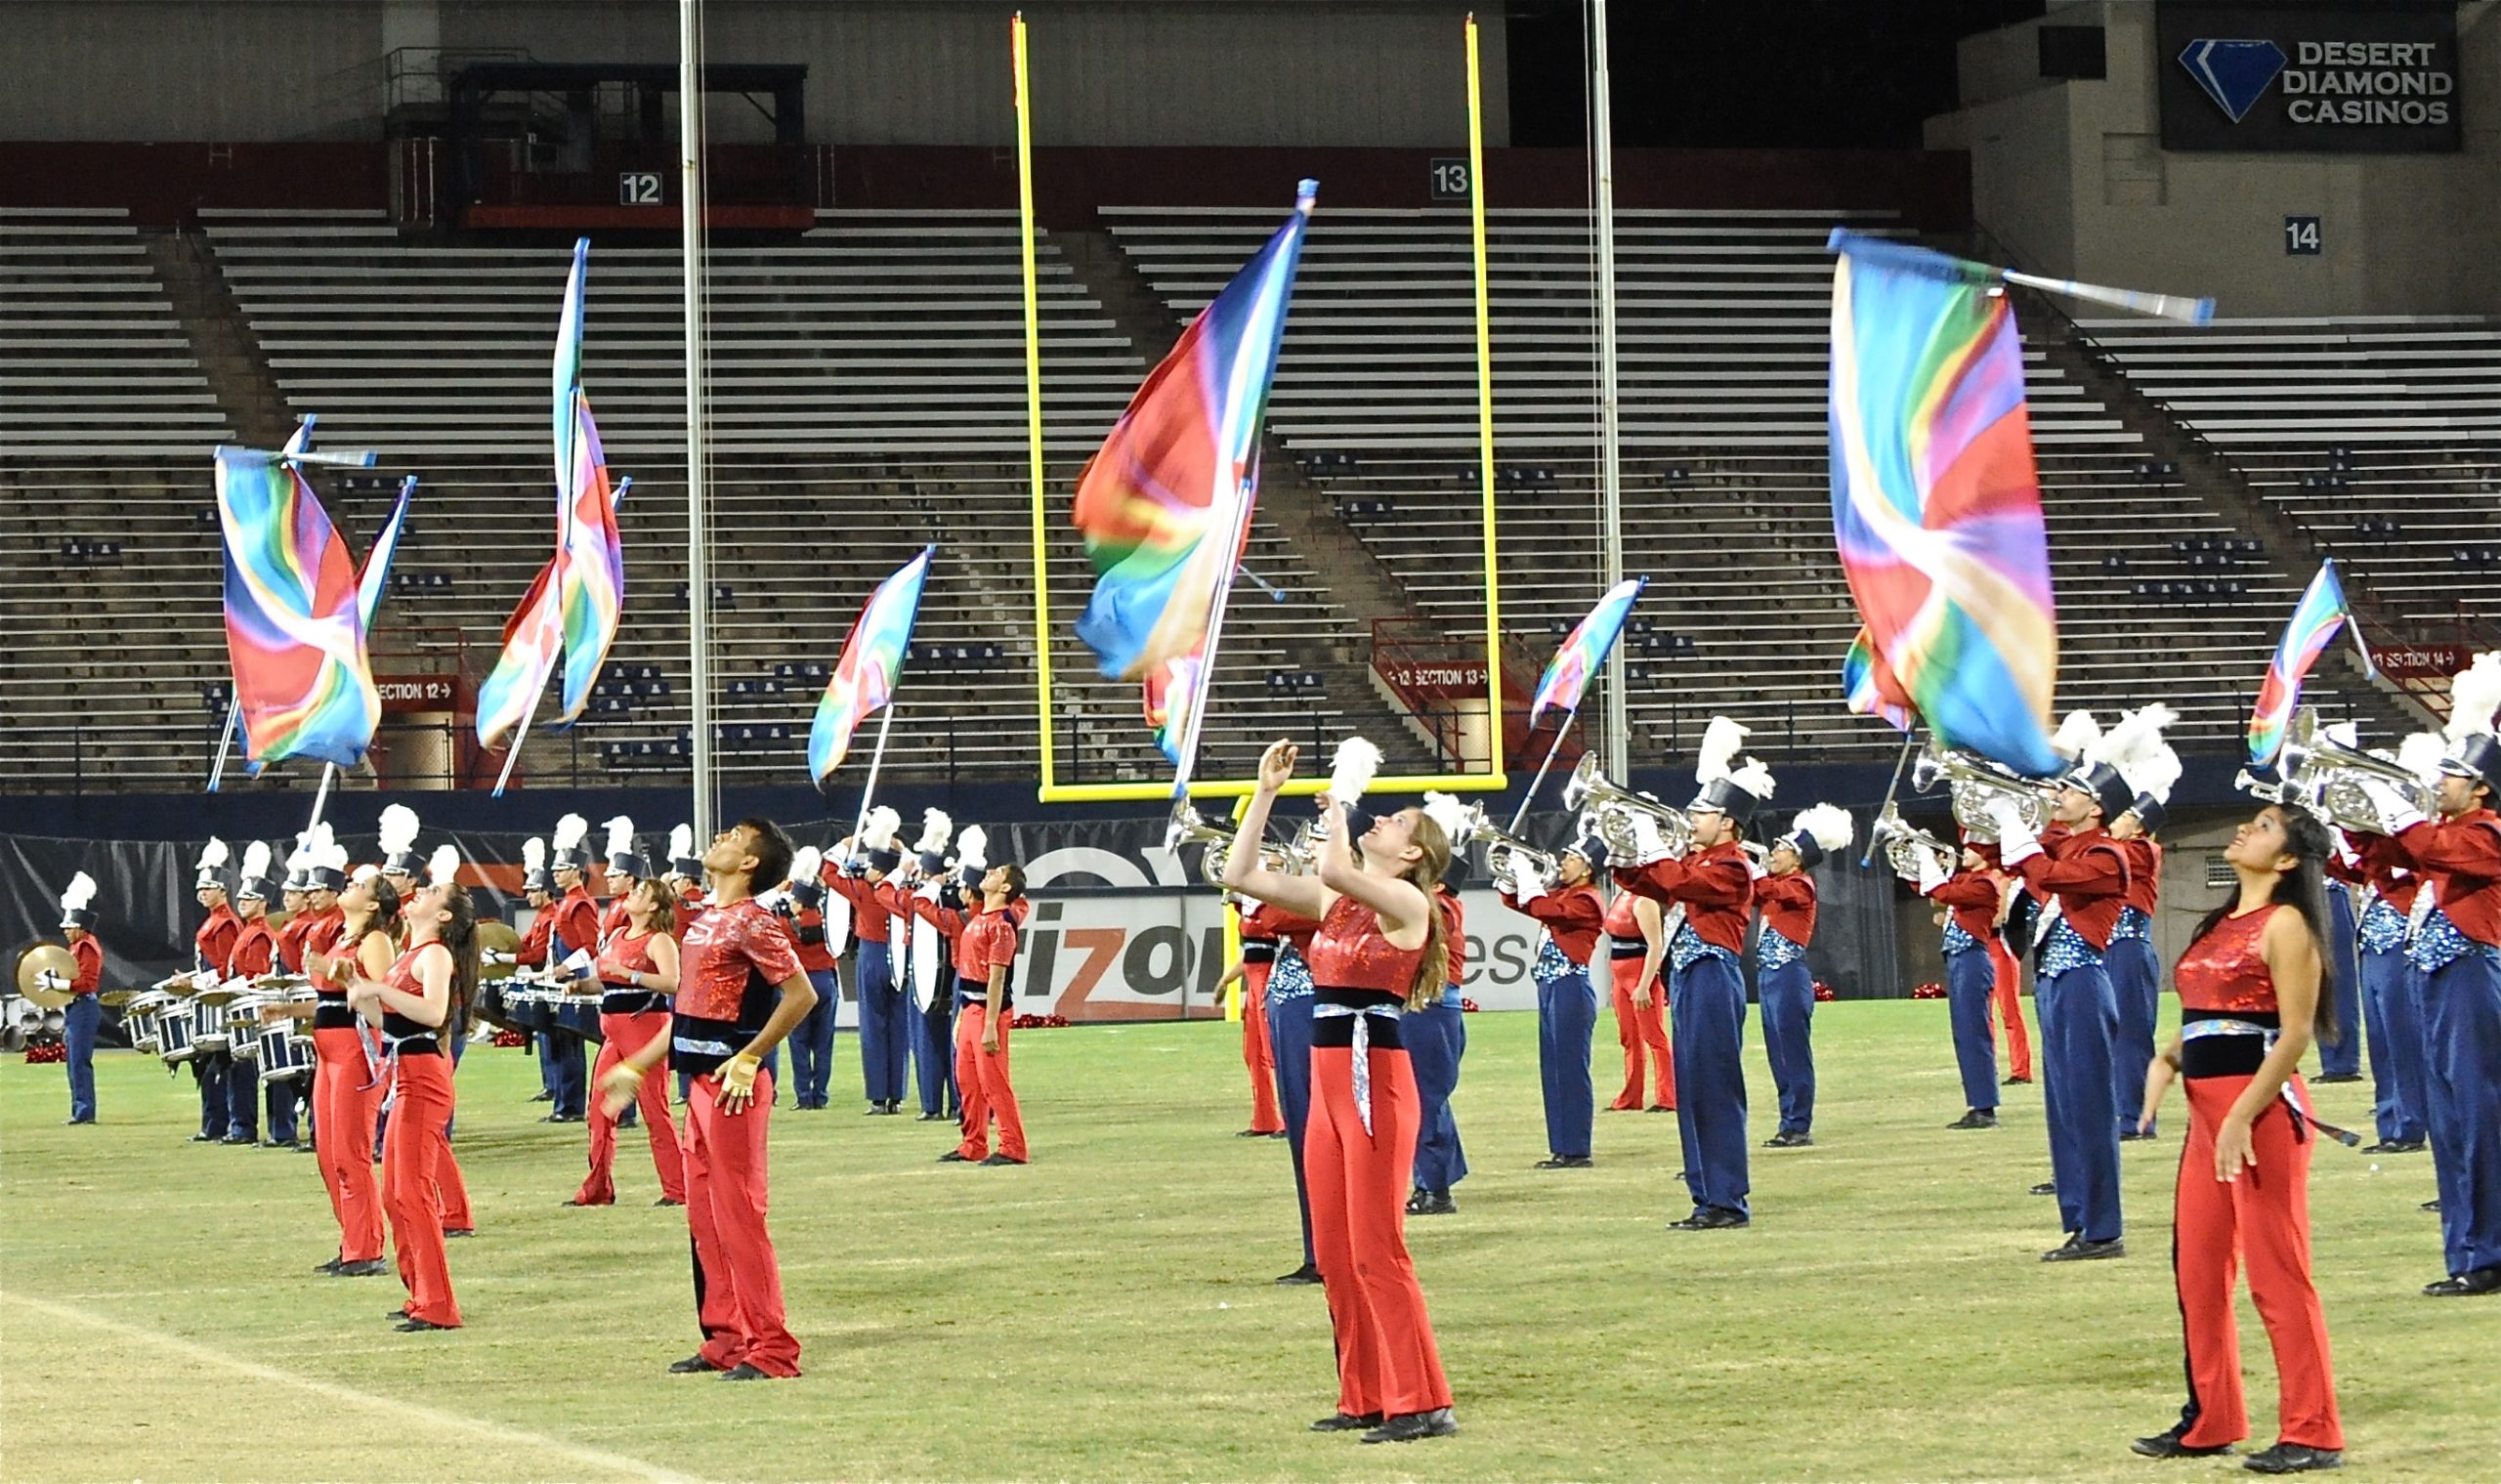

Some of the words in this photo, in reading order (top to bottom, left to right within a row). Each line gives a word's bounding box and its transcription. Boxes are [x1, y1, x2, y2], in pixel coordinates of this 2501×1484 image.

[2298, 41, 2436, 66] DESERT
[2282, 69, 2453, 96] DIAMOND
[2287, 100, 2449, 125] CASINOS
[622, 175, 659, 203] 12
[1433, 165, 1468, 193] 13
[2285, 222, 2319, 249] 14
[2433, 652, 2444, 666] 14
[1415, 669, 1462, 686] SECTION
[1464, 669, 1478, 686] 13
[375, 683, 422, 700] ECTION
[425, 682, 440, 700] 12
